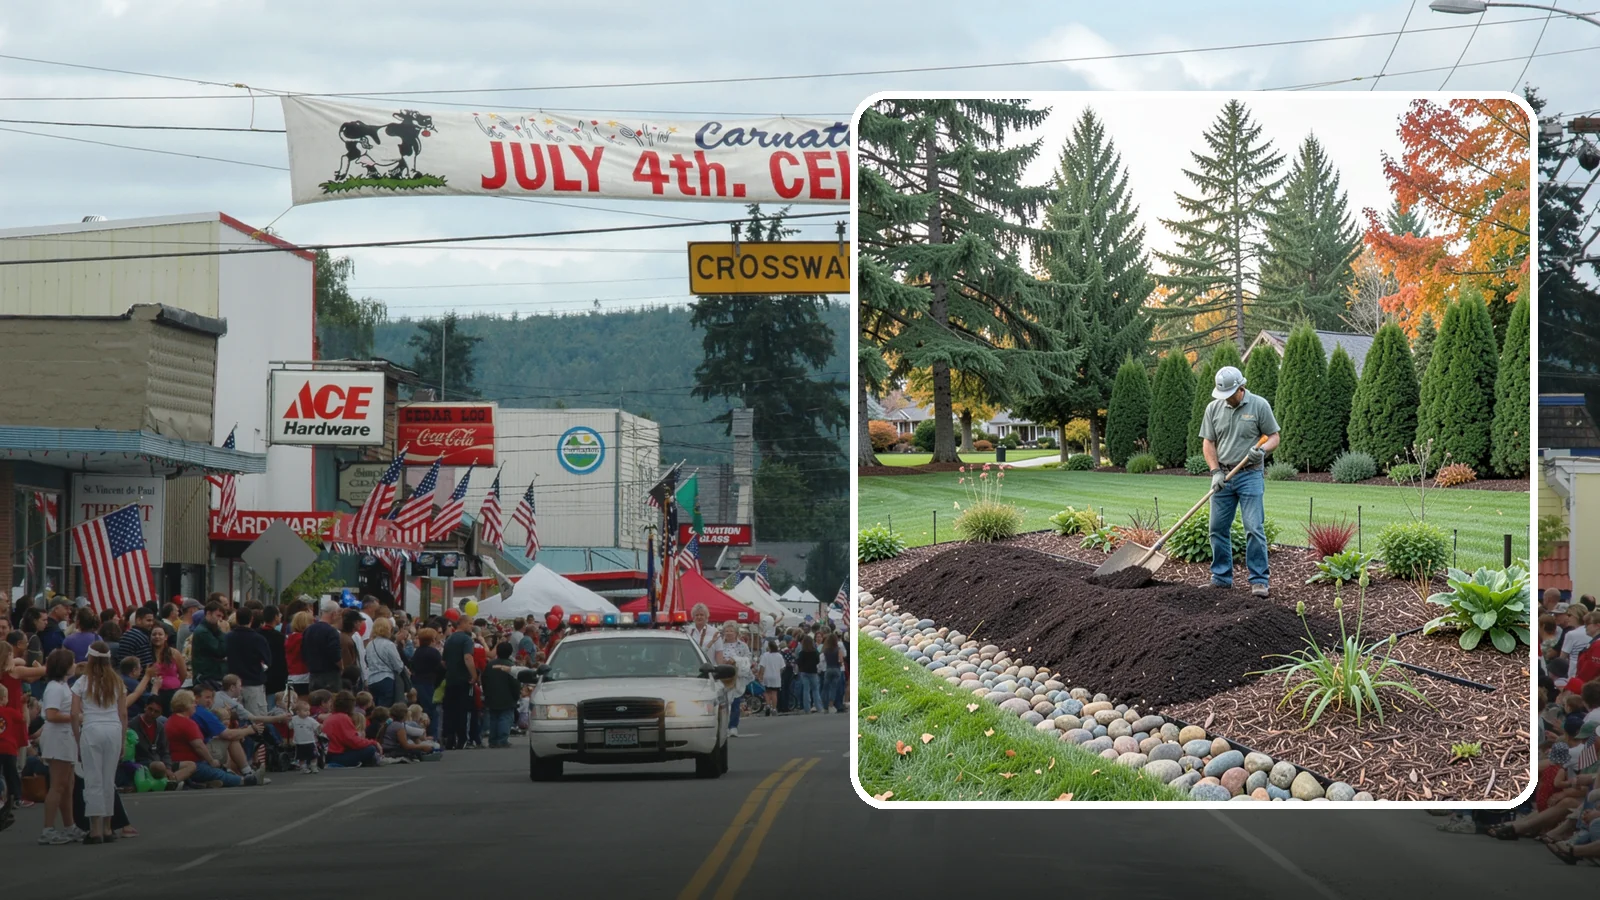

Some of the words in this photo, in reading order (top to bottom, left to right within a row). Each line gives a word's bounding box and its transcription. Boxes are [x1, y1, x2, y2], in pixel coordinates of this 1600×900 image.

[695, 121, 850, 149] Carnat
[481, 141, 605, 192] JULY
[632, 150, 746, 198] 4th.
[697, 254, 850, 280] CROSSWA
[282, 380, 373, 420] ACE
[405, 409, 452, 422] CEDAR
[283, 421, 371, 436] Hardware
[416, 428, 477, 447] Coca-Cola
[83, 484, 94, 494] St.
[95, 484, 124, 495] Vincent
[126, 486, 136, 495] de
[137, 486, 155, 495] Paul
[688, 526, 741, 535] CRNATION
[699, 535, 730, 543] GLASS
